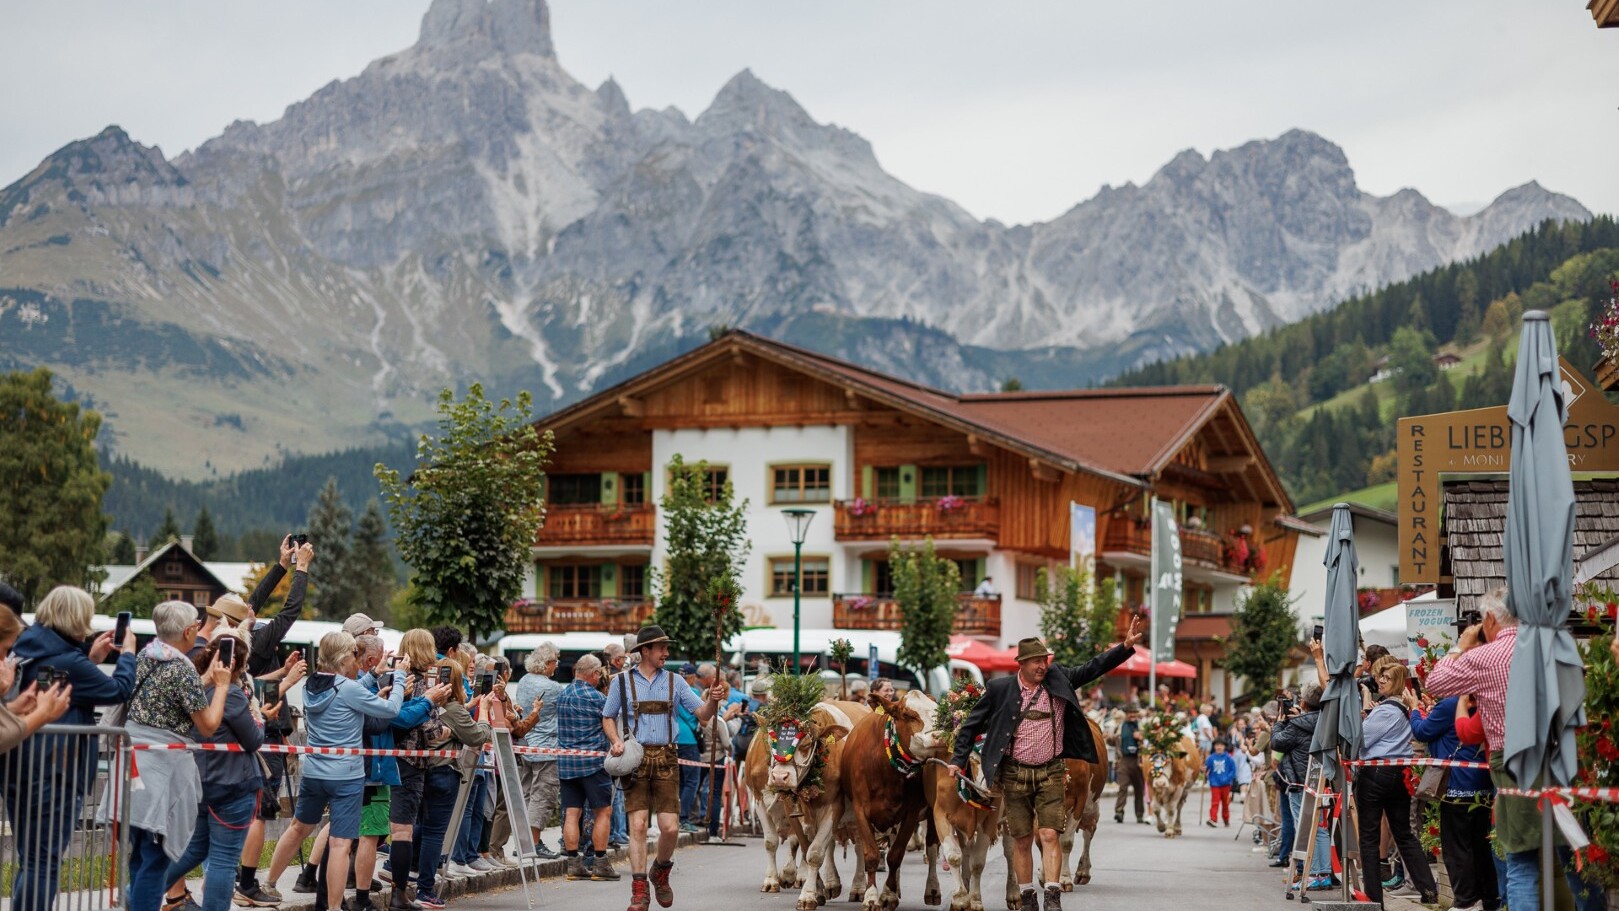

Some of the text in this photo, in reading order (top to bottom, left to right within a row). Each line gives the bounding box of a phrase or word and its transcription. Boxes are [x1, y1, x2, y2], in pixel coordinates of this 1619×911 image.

[1448, 424, 1616, 449] LIEBGSP
[1463, 454, 1504, 466] MONI
[1411, 425, 1427, 575] RESTAURANT
[1408, 608, 1444, 618] FROZEN
[1419, 616, 1454, 626] YOGURT
